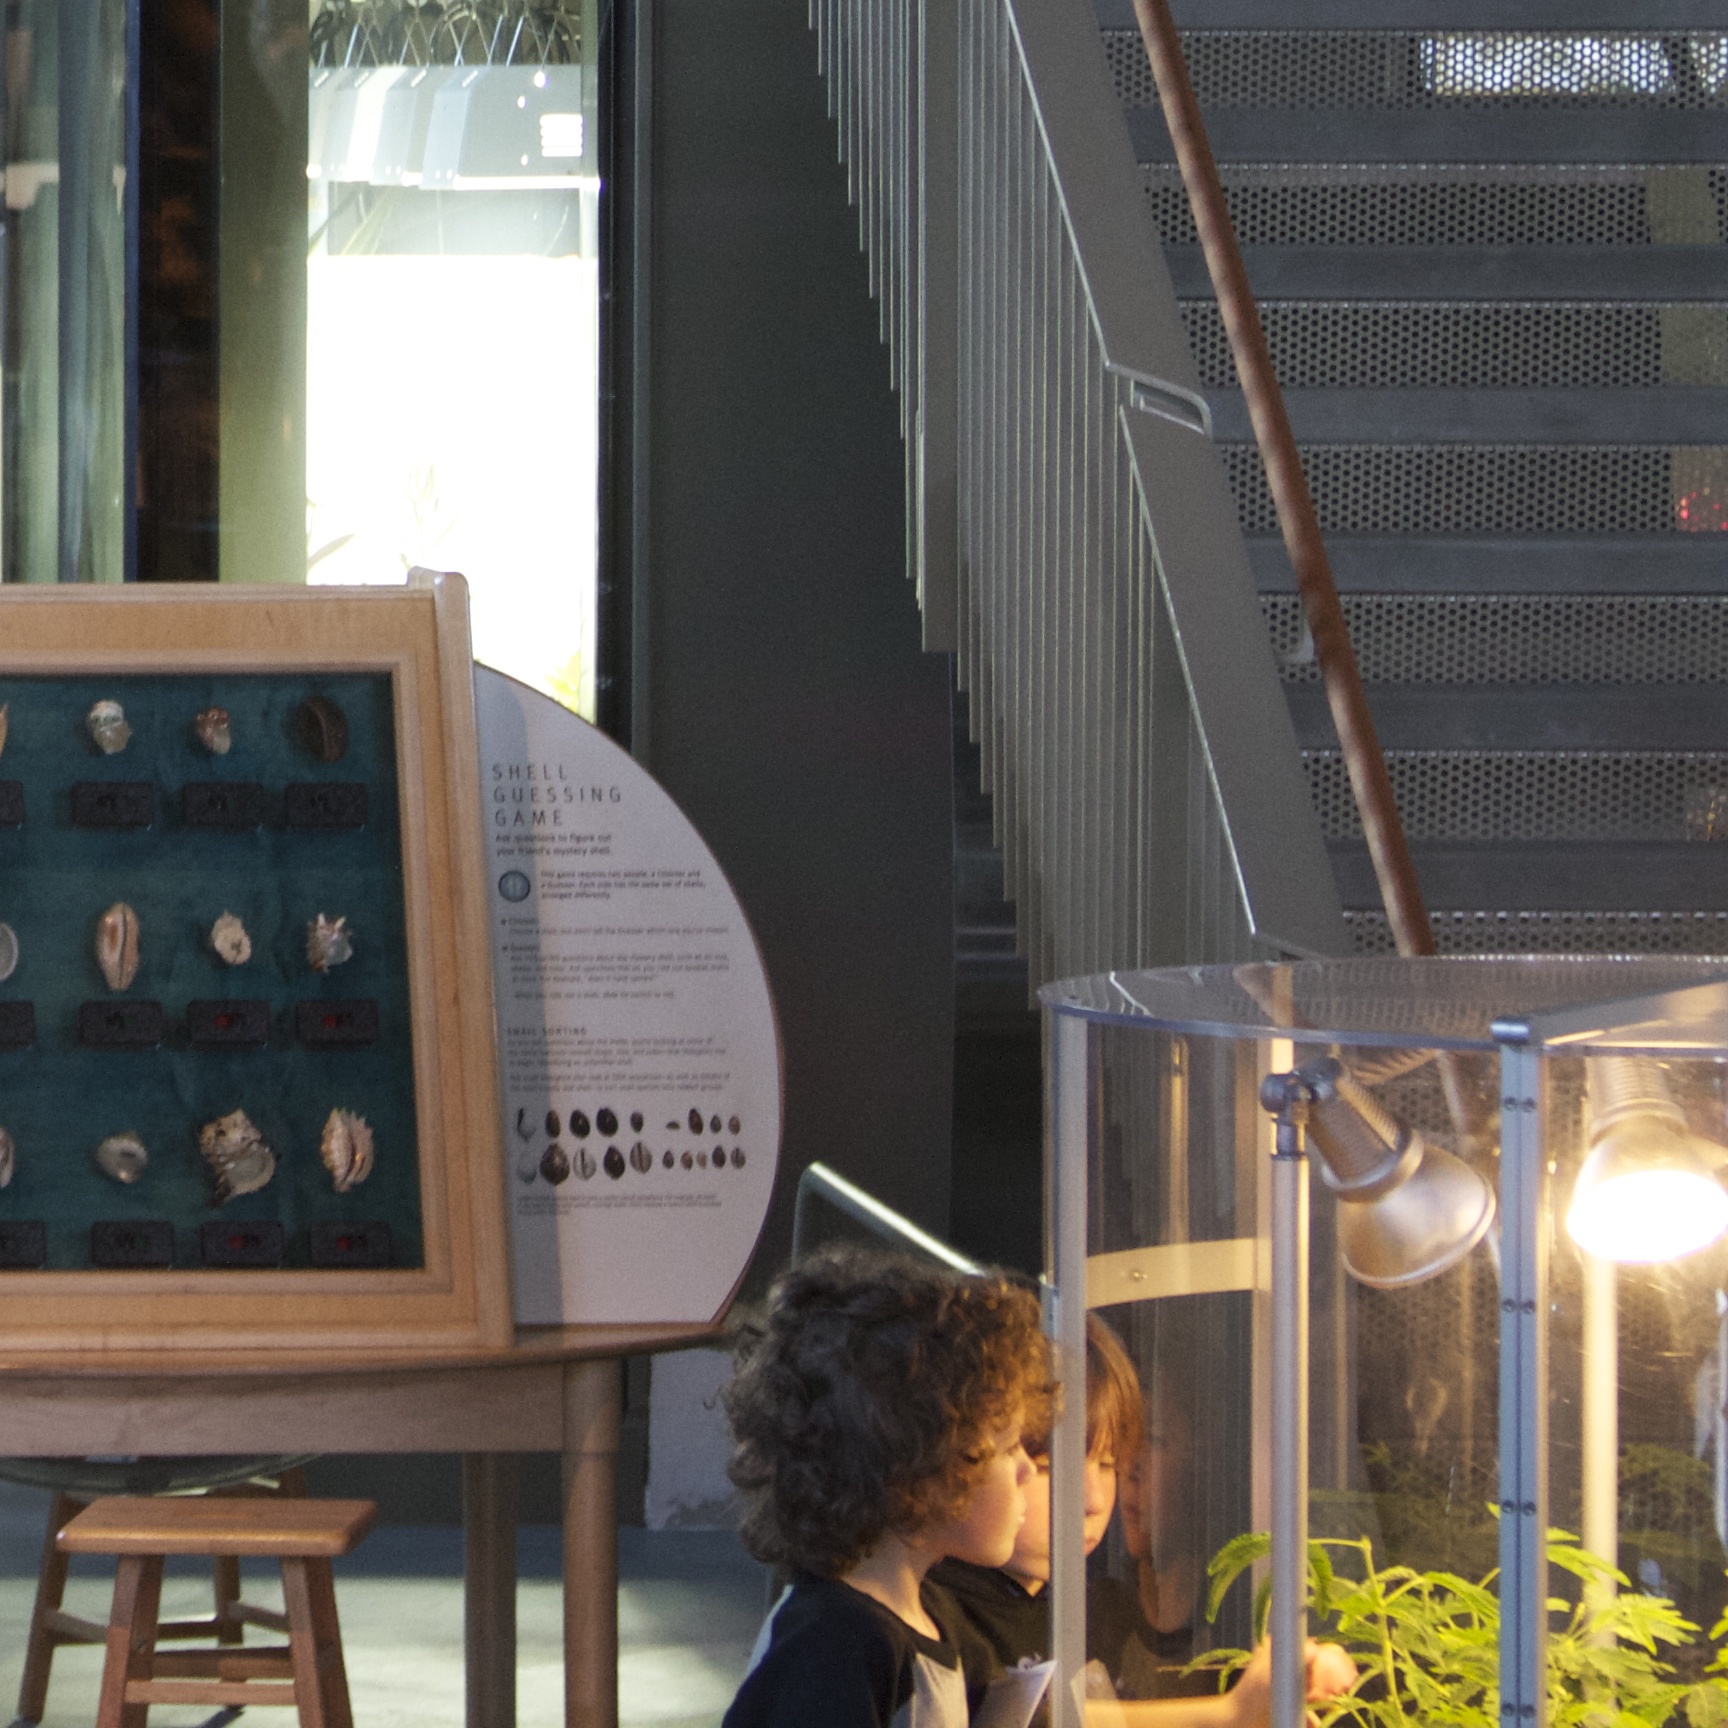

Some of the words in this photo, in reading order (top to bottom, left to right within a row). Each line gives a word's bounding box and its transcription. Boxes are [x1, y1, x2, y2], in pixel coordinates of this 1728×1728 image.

[492, 763, 566, 781] SHELL
[493, 786, 621, 803] GUESSING
[495, 809, 562, 827] GAME
